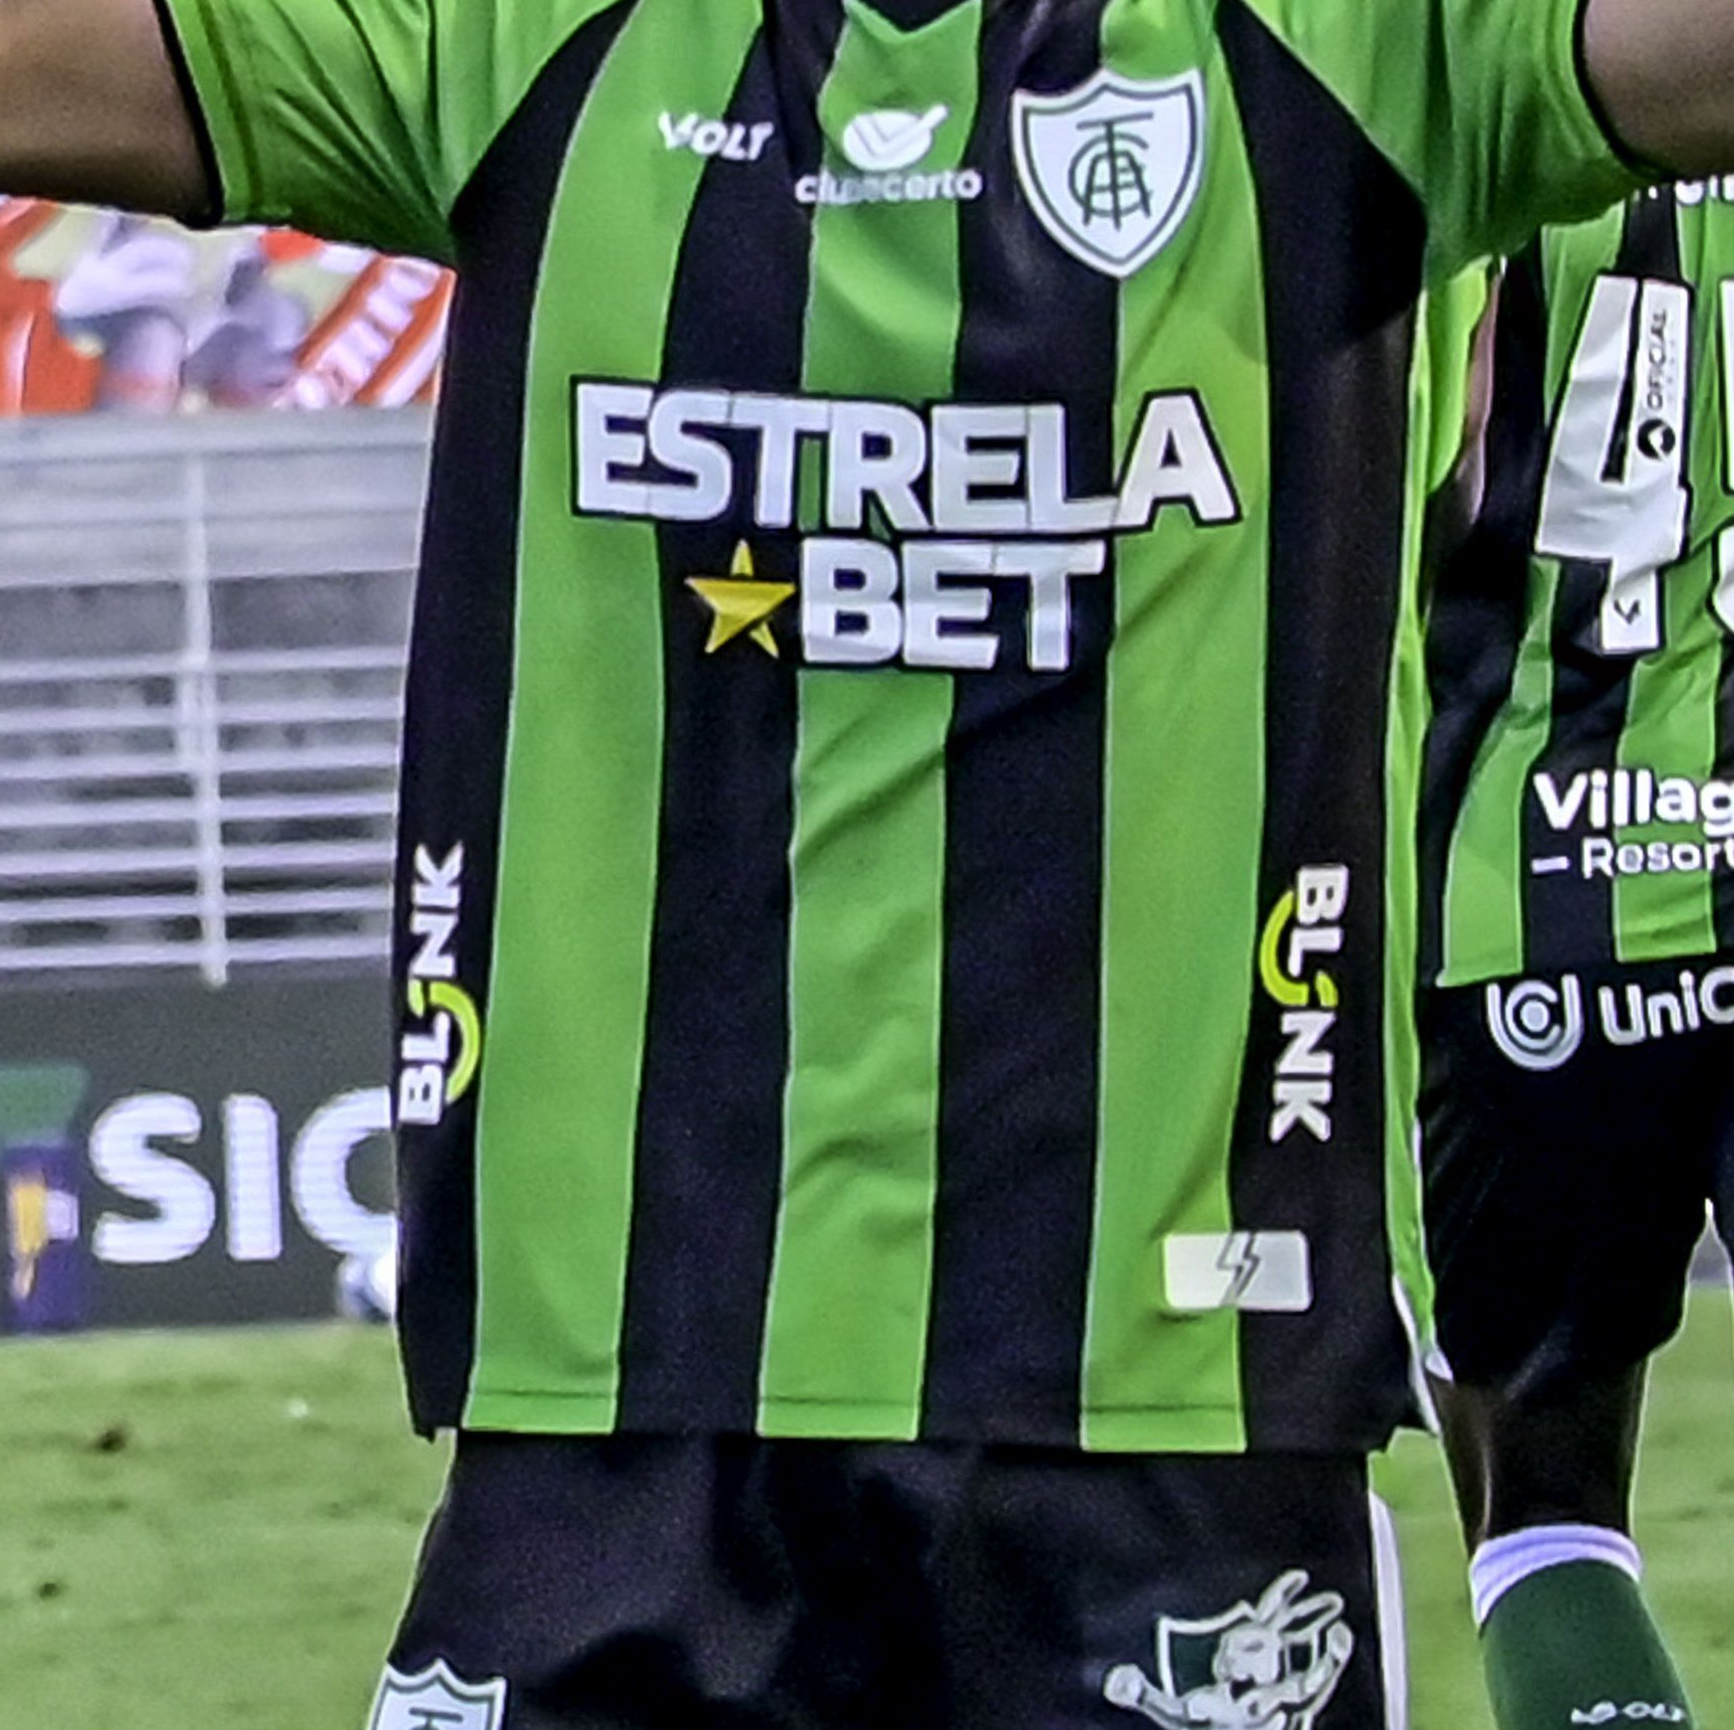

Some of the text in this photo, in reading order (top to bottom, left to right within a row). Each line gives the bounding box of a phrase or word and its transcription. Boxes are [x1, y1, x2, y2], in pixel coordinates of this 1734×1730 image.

[658, 110, 774, 161] VOLT
[573, 382, 1241, 532] ESTRELA
[799, 536, 1107, 671] BET
[89, 1085, 394, 1265] SIC
